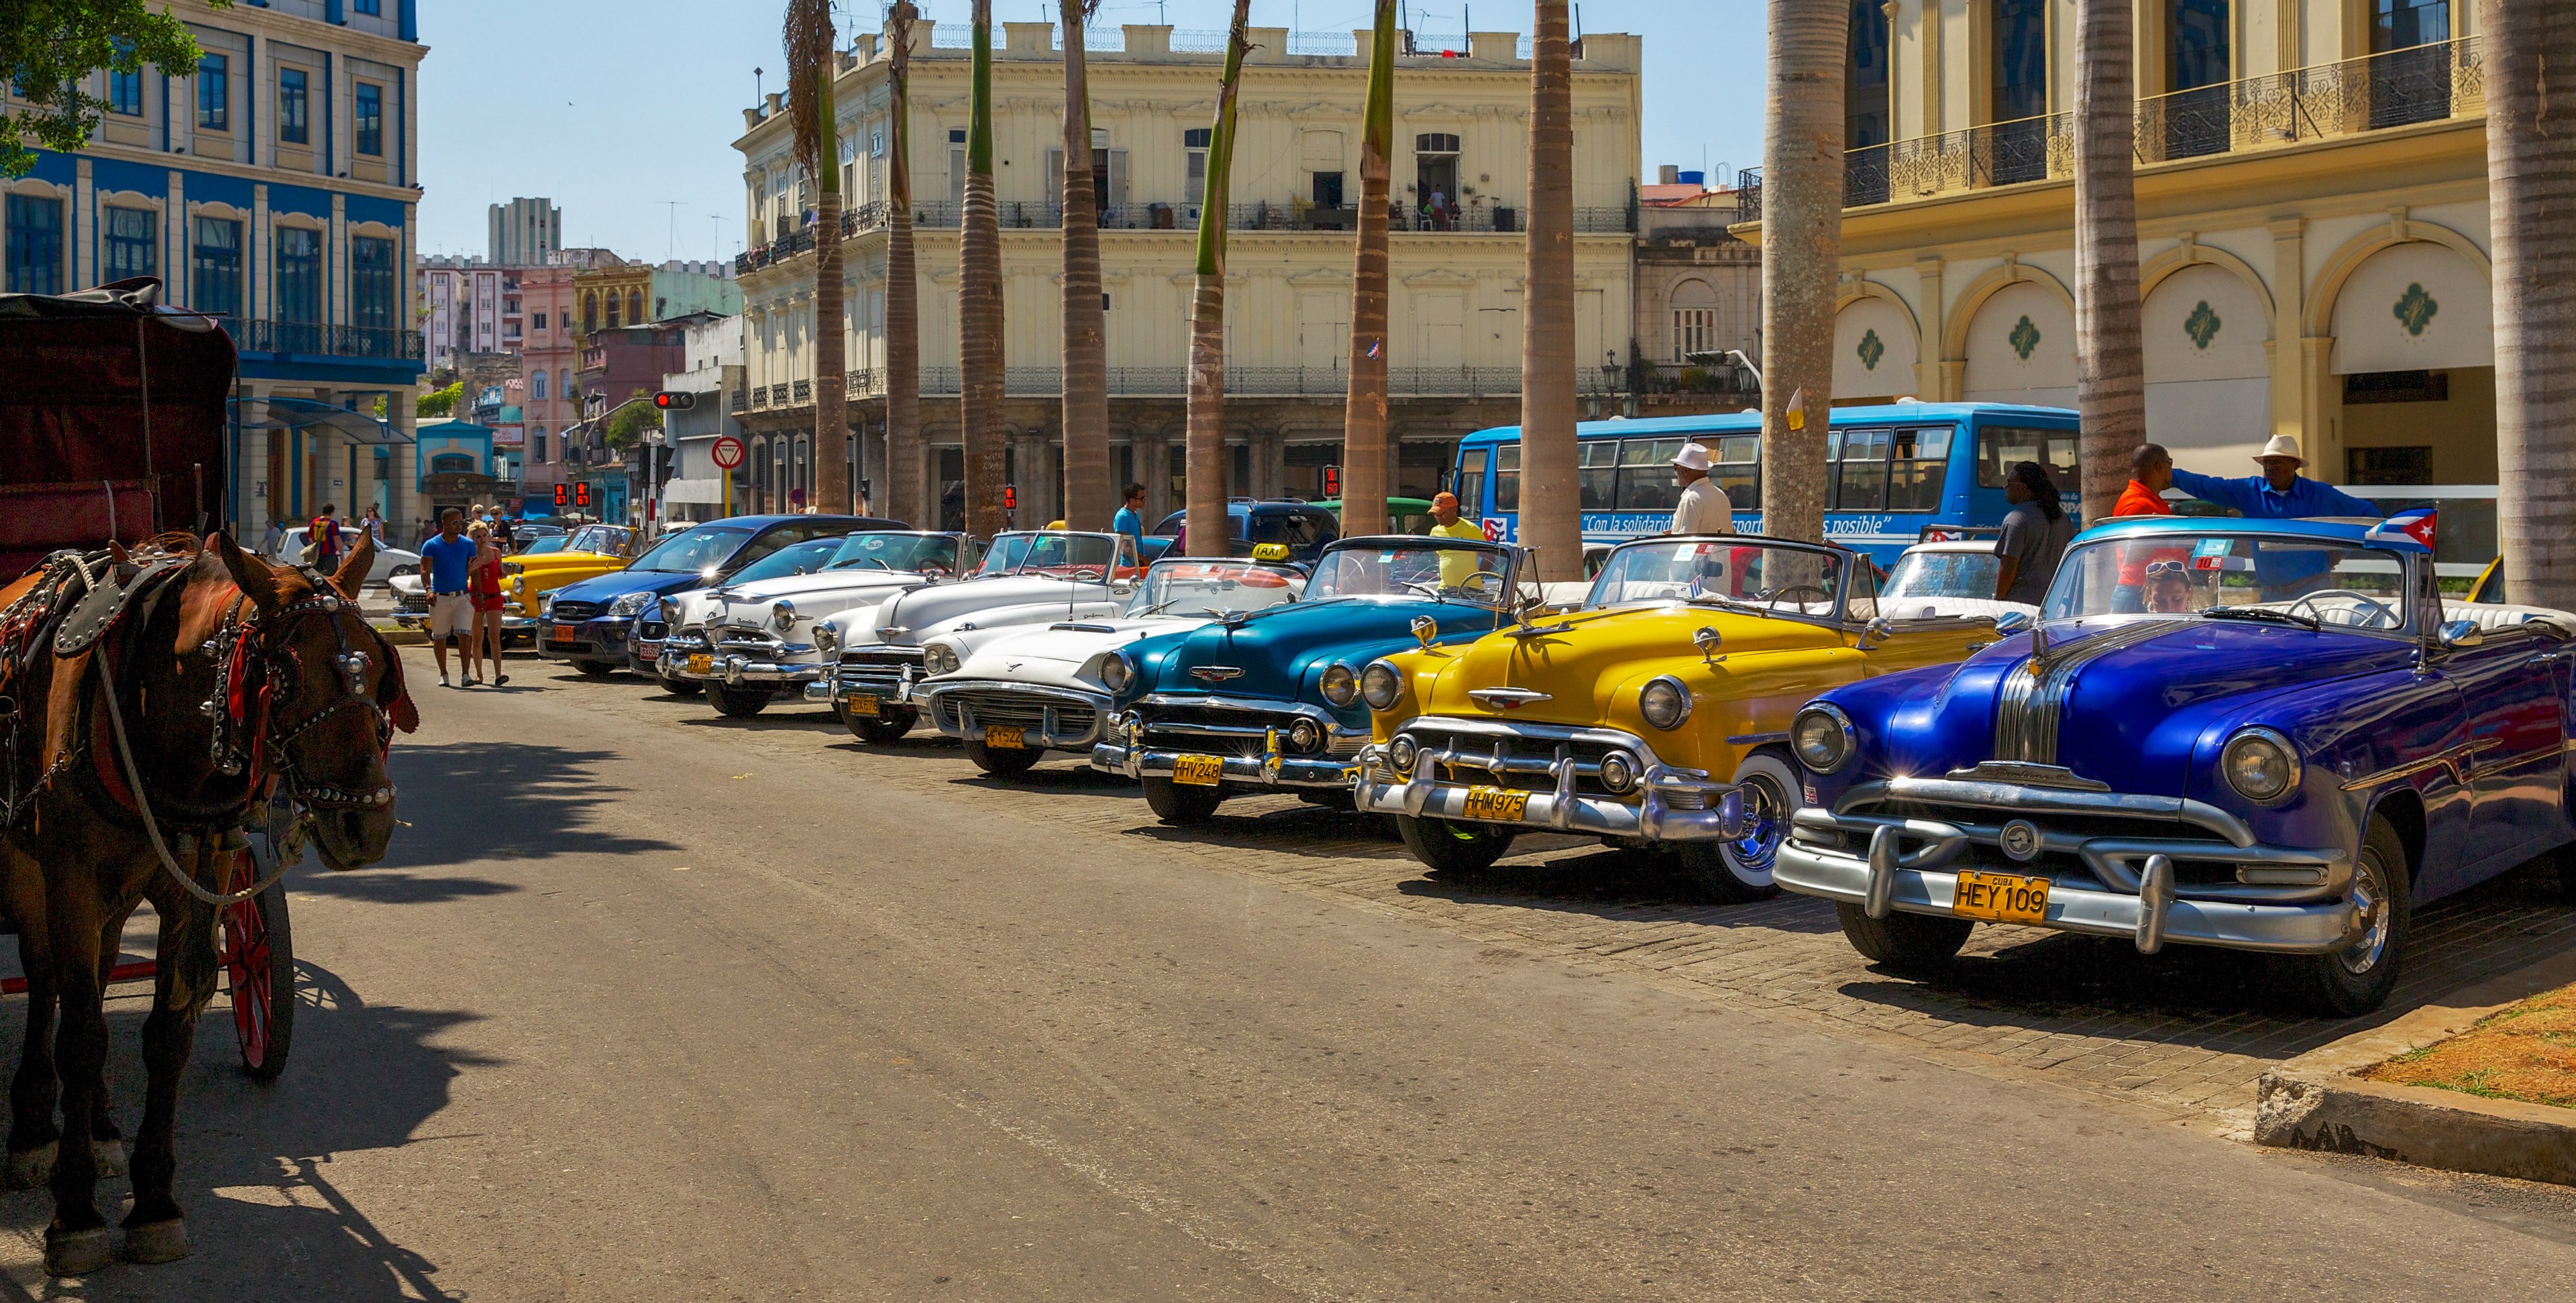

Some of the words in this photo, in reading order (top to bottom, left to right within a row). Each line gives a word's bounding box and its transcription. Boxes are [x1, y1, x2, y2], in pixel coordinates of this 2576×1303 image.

[1327, 483, 1338, 494] 67
[556, 495, 566, 505] 67
[578, 495, 588, 505] 67
[1609, 515, 1620, 532] la
[1731, 518, 1764, 534] sport
[1832, 515, 1892, 534] posible”
[1256, 546, 1279, 557] TAXI
[2198, 558, 2212, 569] 10
[640, 646, 659, 657] T33509
[1175, 761, 1220, 779] HHV248
[1465, 792, 1525, 812] HHM975
[1992, 876, 2013, 886] CUBA
[1955, 881, 2045, 913] HEY109
